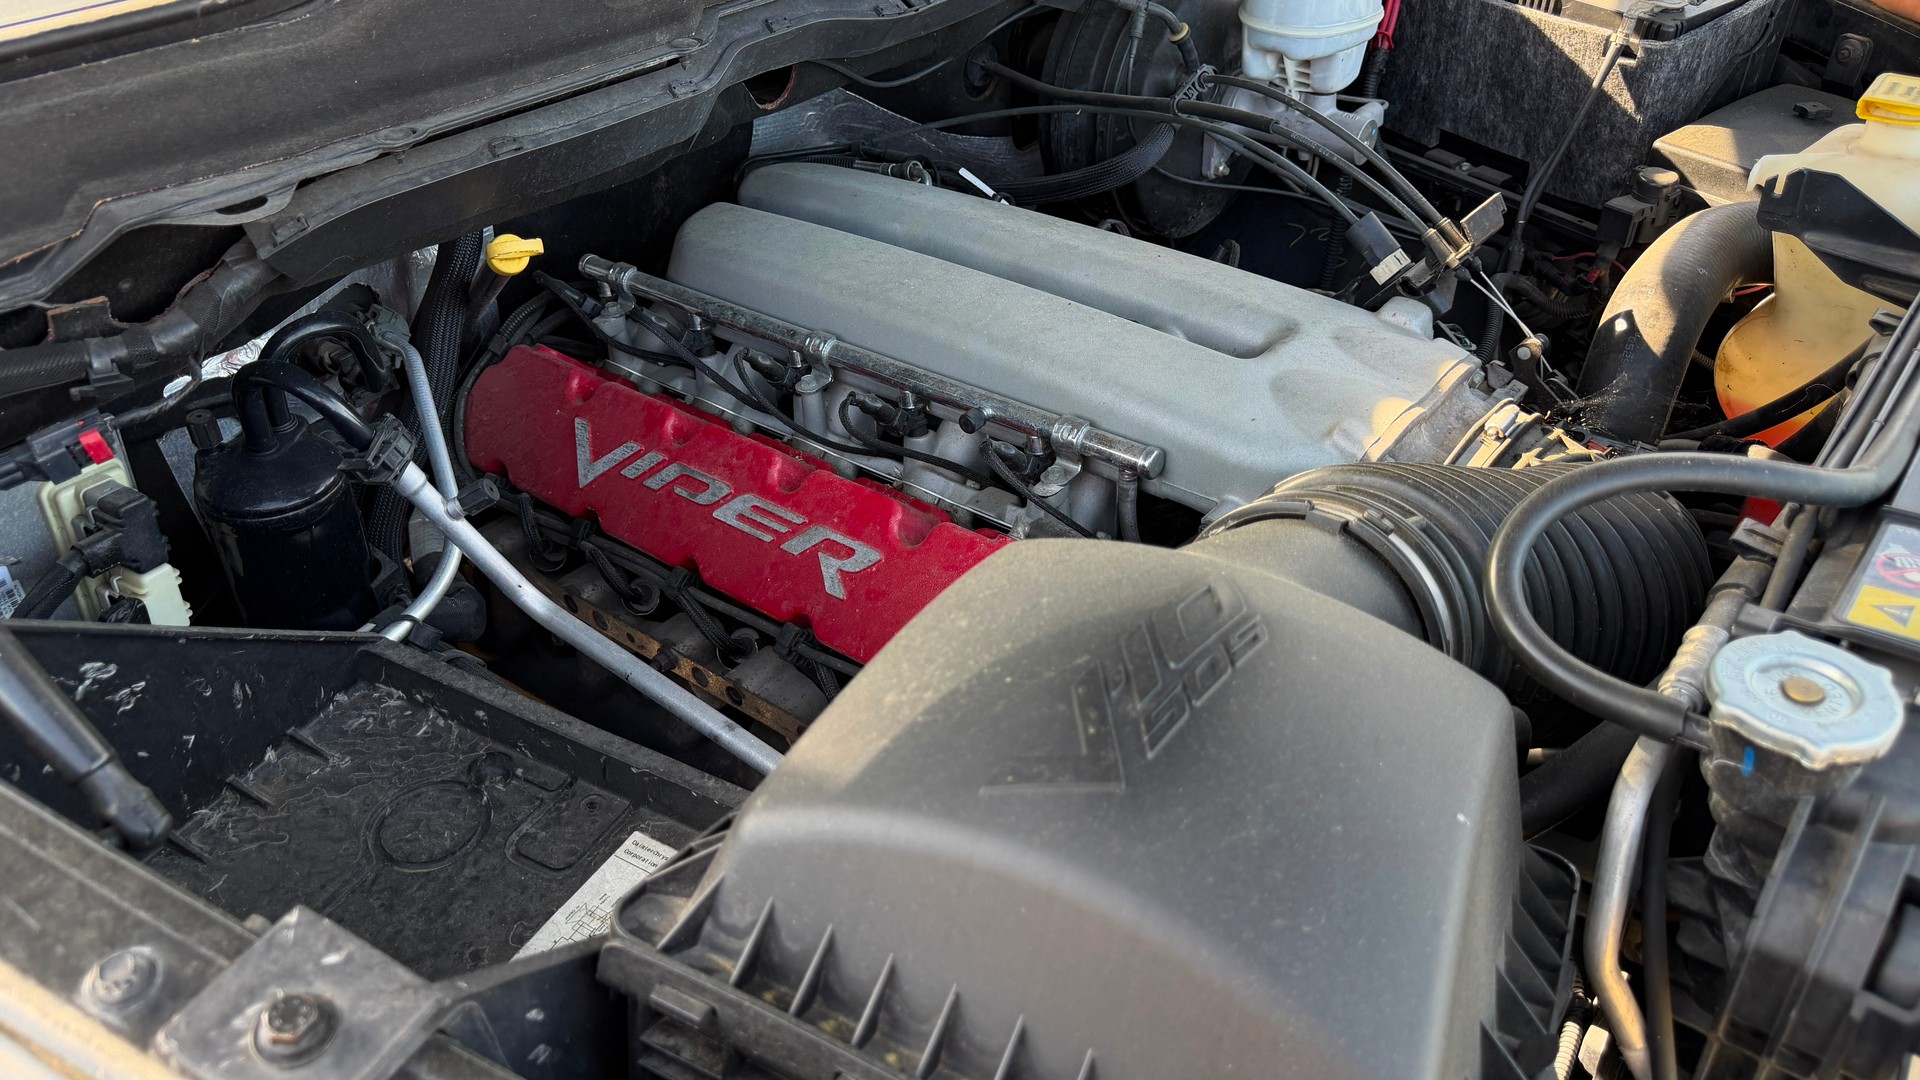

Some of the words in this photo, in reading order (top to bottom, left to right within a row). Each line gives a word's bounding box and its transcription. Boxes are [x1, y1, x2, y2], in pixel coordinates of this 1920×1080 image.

[574, 416, 884, 600] VIPER
[623, 848, 659, 869] Corporation
[631, 839, 671, 861] DaimlerChrys
